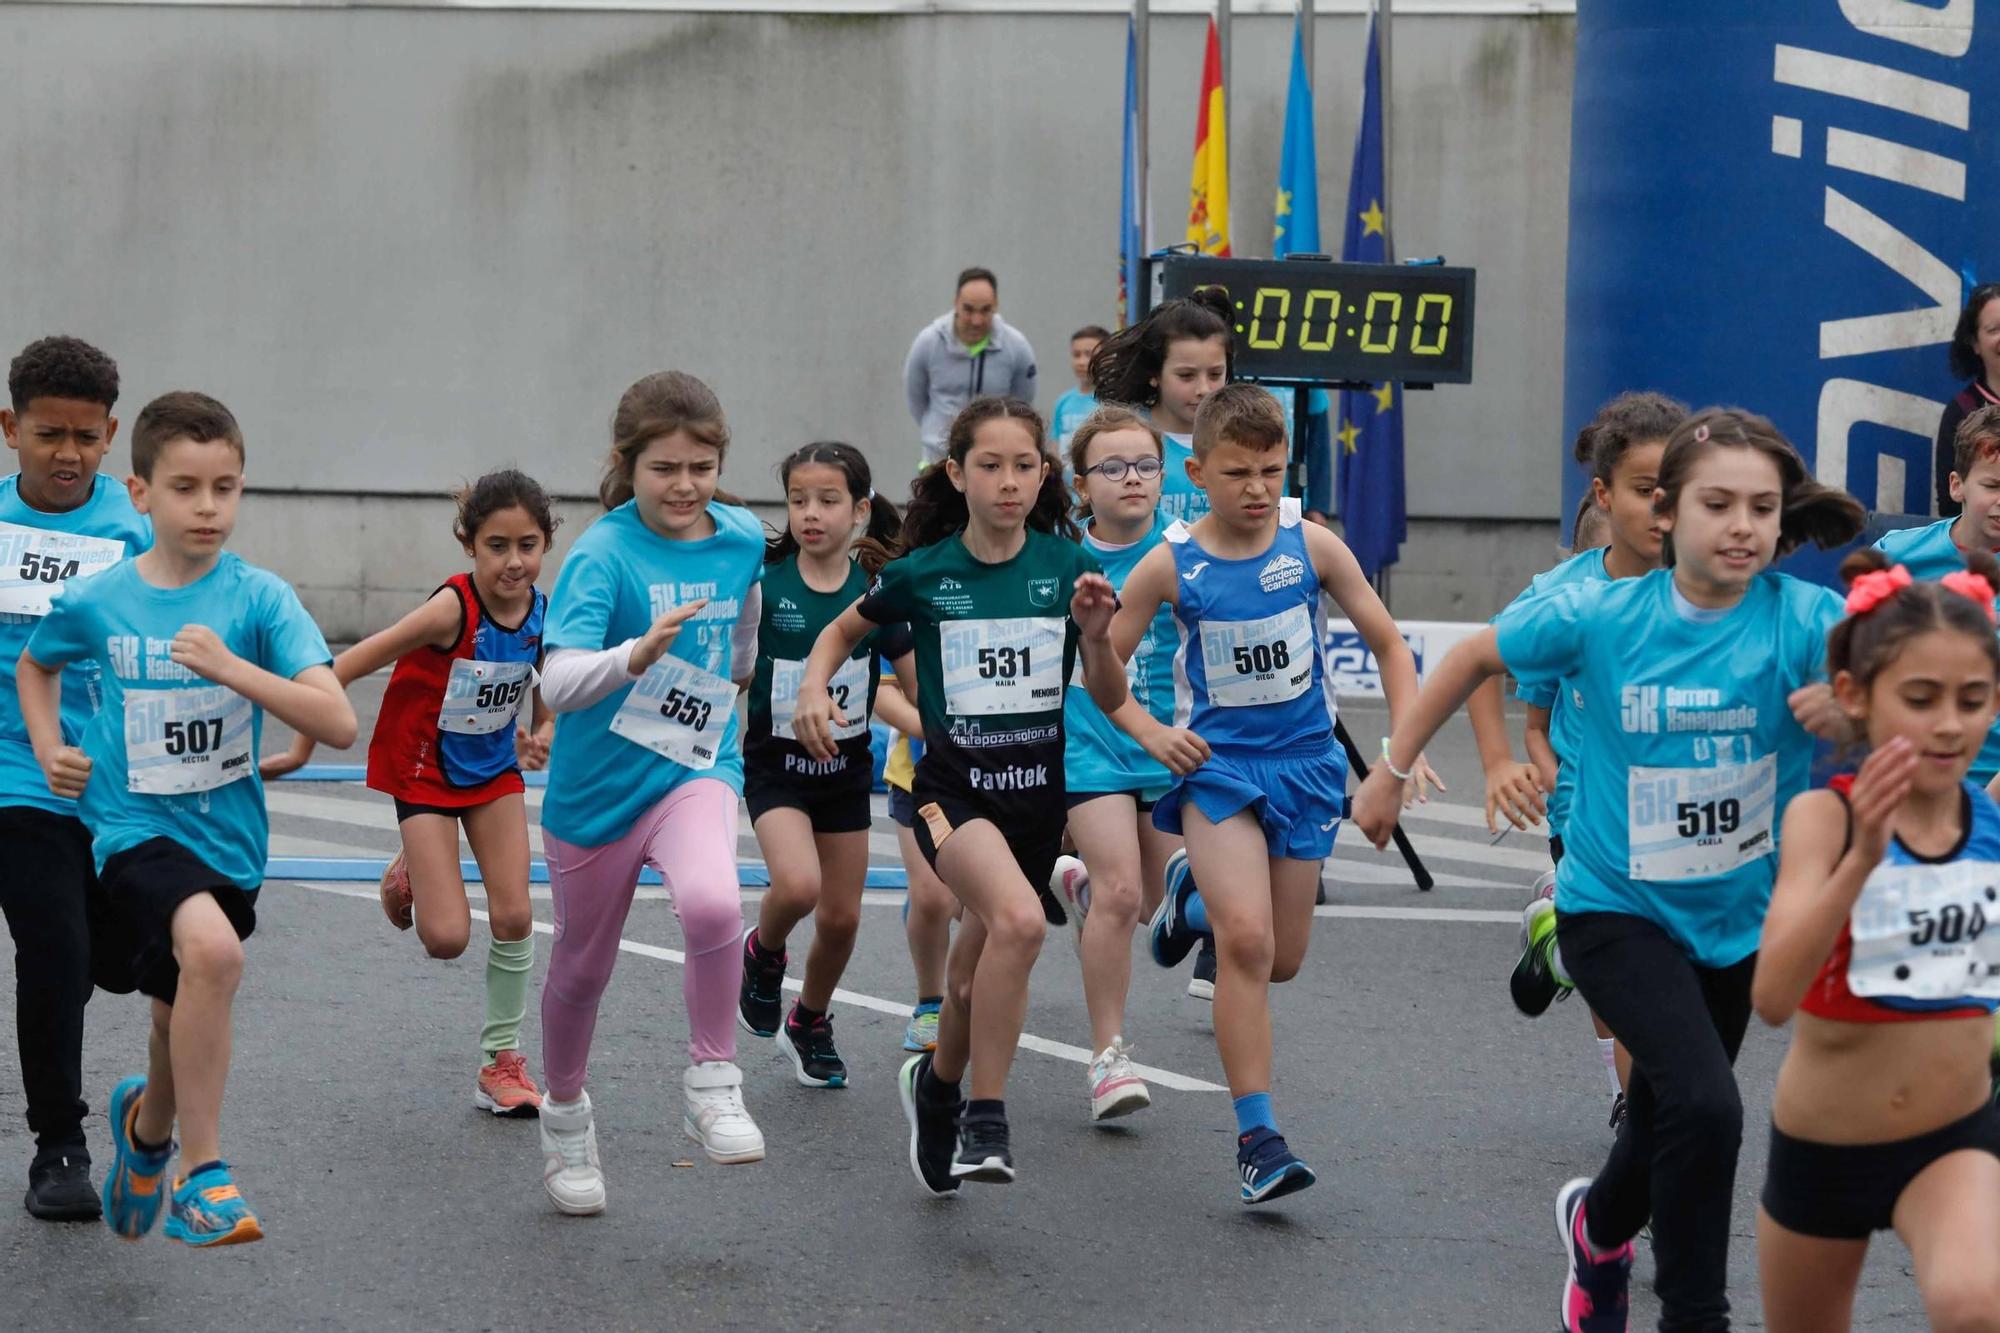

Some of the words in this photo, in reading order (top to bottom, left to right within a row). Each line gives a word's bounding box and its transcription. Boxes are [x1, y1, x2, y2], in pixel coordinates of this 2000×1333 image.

[1772, 0, 1975, 517] avil
[1193, 285, 1453, 355] :00:00
[20, 552, 80, 584] 554
[1260, 566, 1304, 586] senderos
[107, 635, 140, 680] 5K
[146, 637, 173, 656] Carr
[978, 647, 1031, 679] 531
[1233, 640, 1290, 675] 508
[1031, 686, 1060, 699] MENORES
[1256, 673, 1275, 681] DIEGO
[476, 680, 523, 708] 505
[660, 687, 712, 732] 553
[1621, 684, 1660, 734] 5K
[164, 717, 223, 756] 507
[970, 764, 1047, 791] Pavitek
[1677, 798, 1741, 839] 519
[1697, 838, 1723, 847] CARLA
